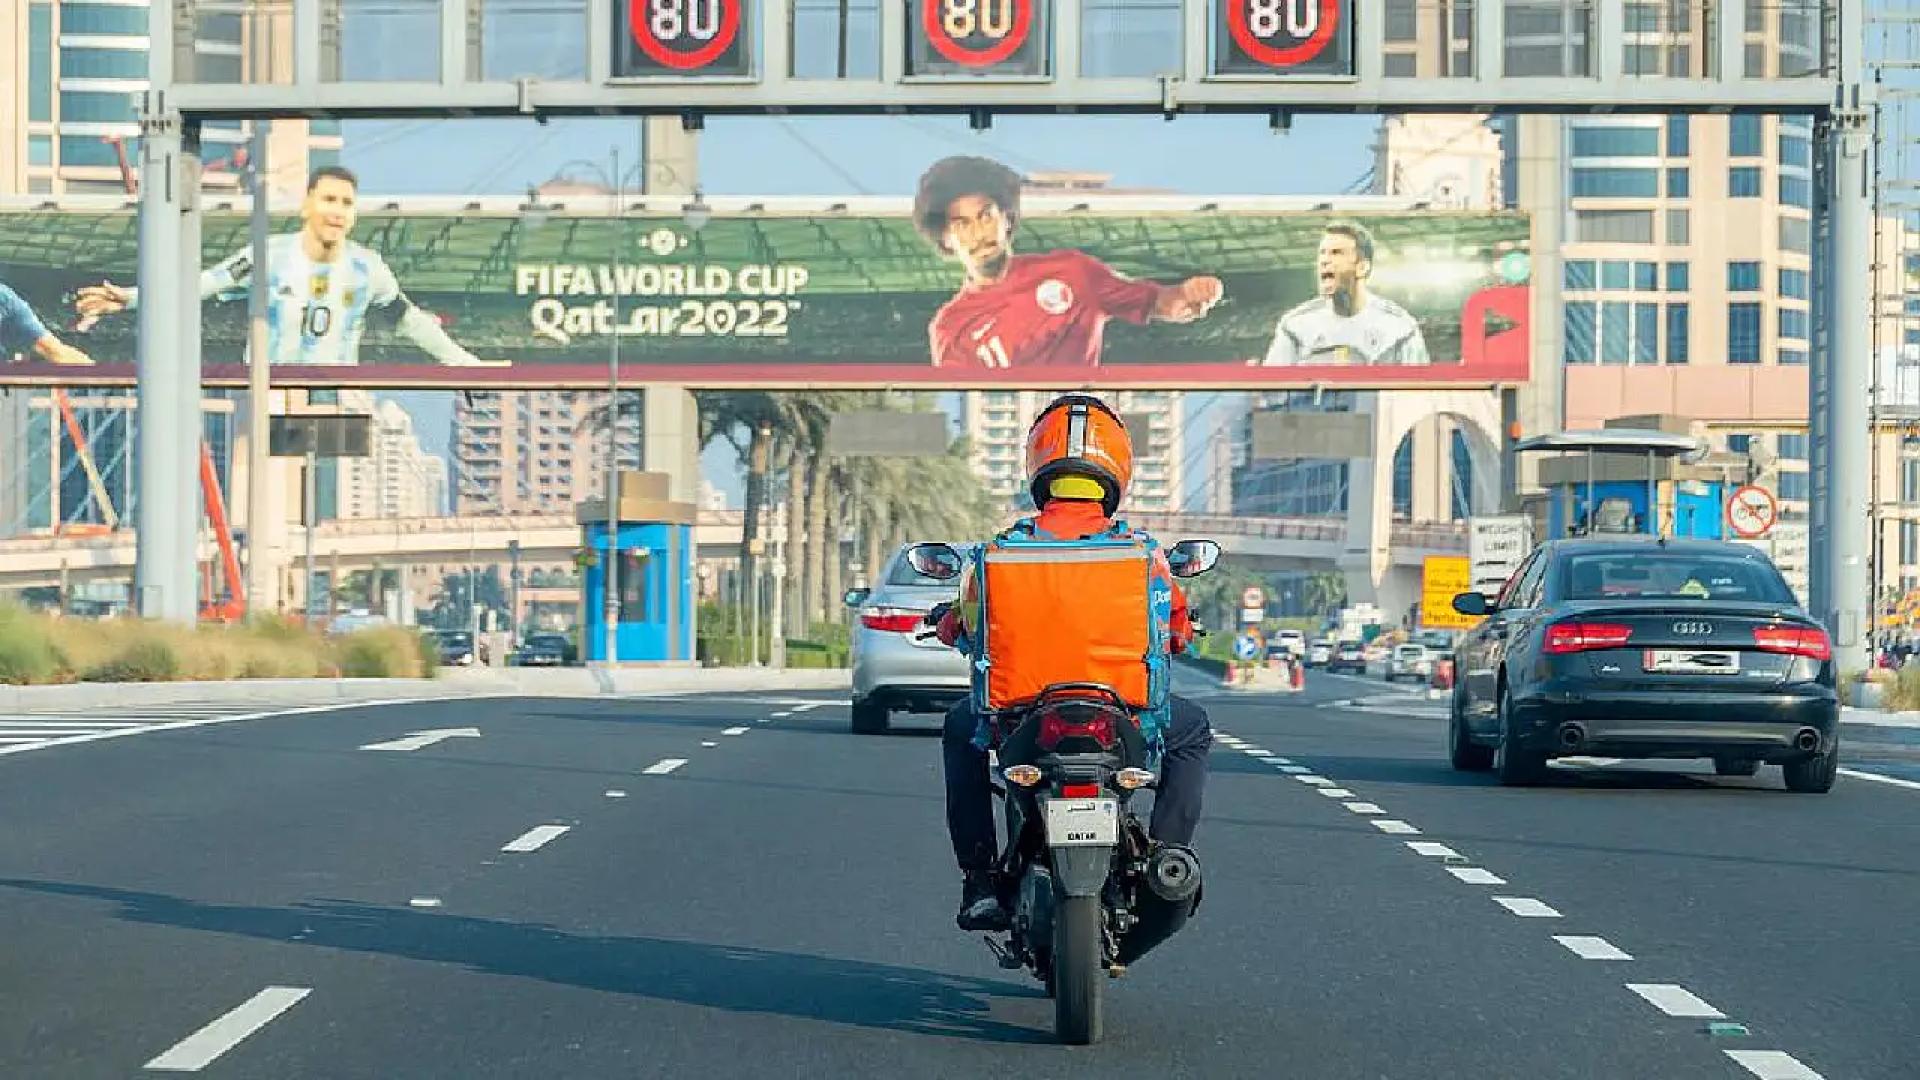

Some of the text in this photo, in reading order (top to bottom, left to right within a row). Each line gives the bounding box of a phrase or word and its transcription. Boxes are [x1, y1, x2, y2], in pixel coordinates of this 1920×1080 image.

[651, 0, 719, 40] 80
[944, 0, 1012, 38] 80
[1250, 0, 1318, 38] 80
[515, 264, 809, 296] FIFA WORLD CUP
[300, 305, 331, 337] 10
[976, 335, 1009, 369] 11
